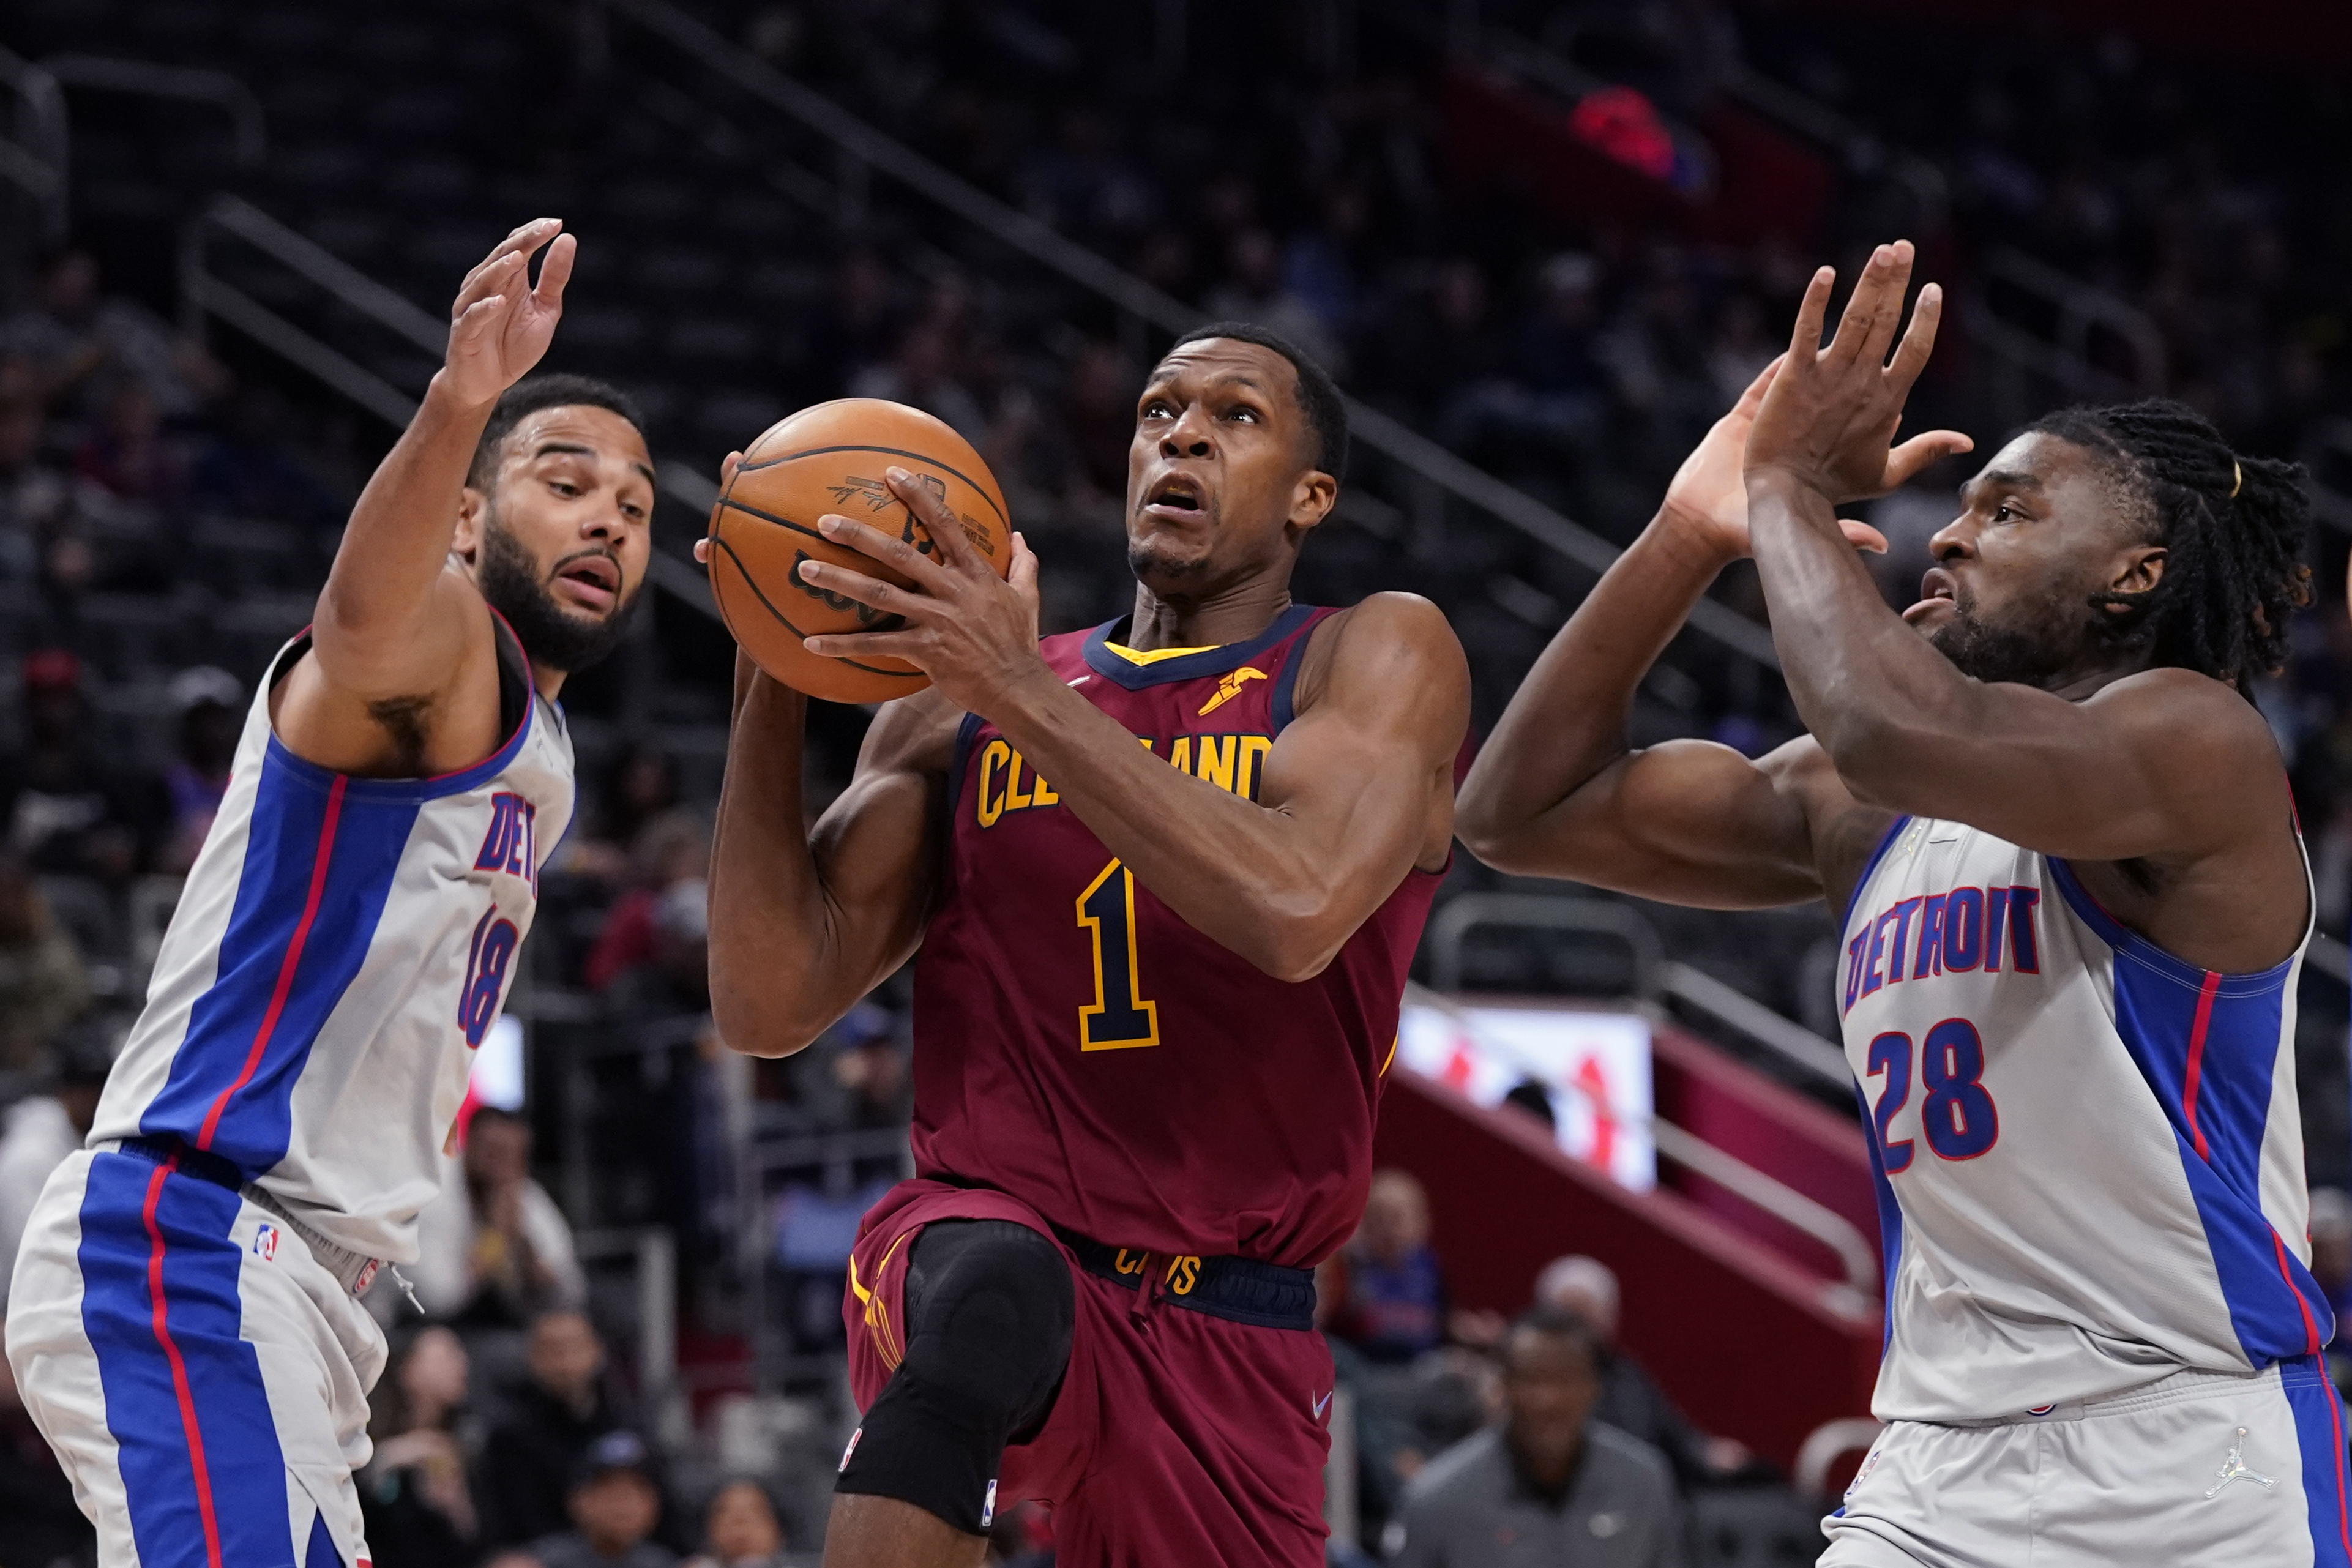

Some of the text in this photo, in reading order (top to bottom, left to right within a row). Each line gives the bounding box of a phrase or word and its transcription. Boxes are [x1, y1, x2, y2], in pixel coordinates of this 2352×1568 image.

[1076, 857, 1160, 1052] 1
[1843, 886, 2040, 1021] DETROIT
[1867, 1018, 1999, 1176] 28
